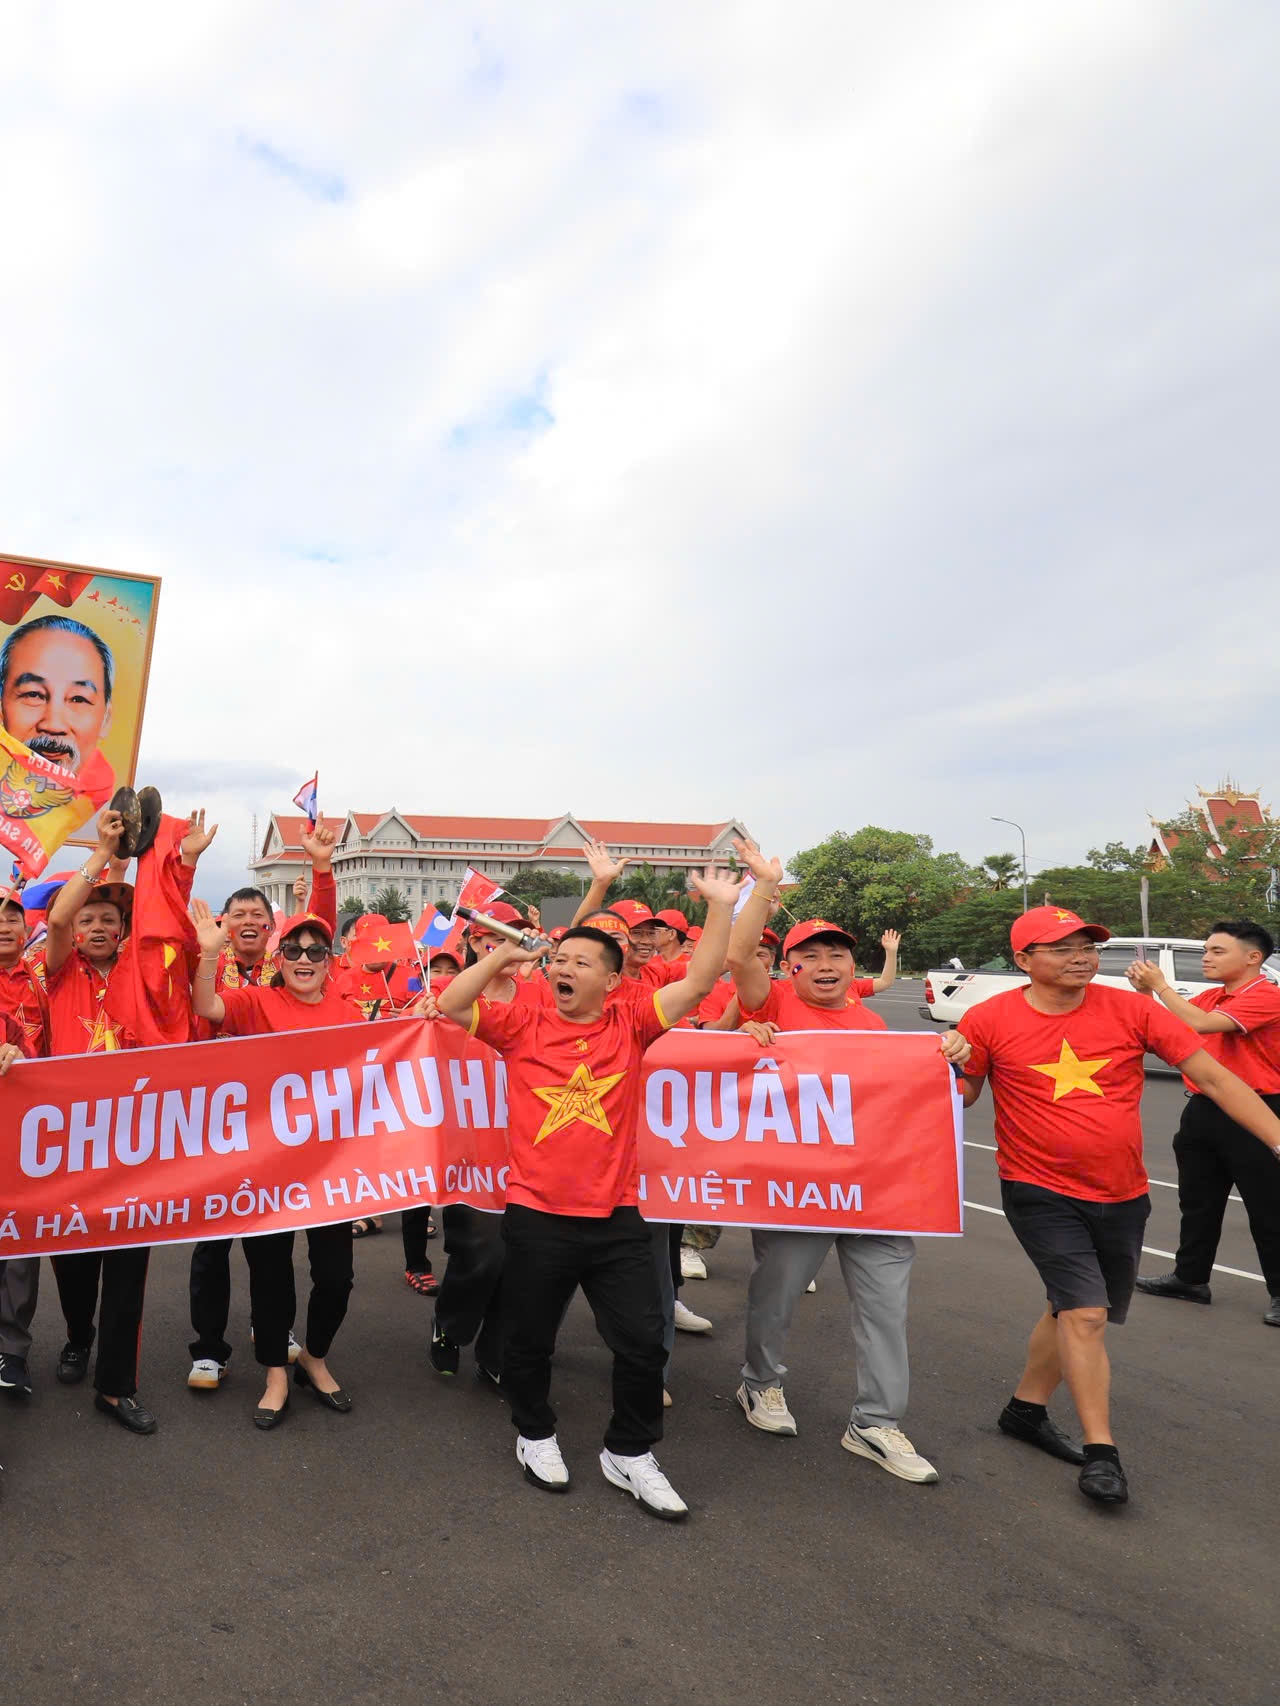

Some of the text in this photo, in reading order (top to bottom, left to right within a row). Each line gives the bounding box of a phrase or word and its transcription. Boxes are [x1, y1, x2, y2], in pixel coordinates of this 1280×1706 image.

[20, 1077, 250, 1177] CHÚNG
[270, 1048, 445, 1146] CHÁU
[645, 1057, 855, 1148] QUÂN
[35, 1203, 88, 1238] HÀ
[103, 1196, 190, 1231] TĨNH
[204, 1178, 311, 1219] ĐỒNG
[323, 1165, 437, 1206] HÀNH
[660, 1170, 752, 1210] VIỆT
[768, 1180, 863, 1211] NAM
